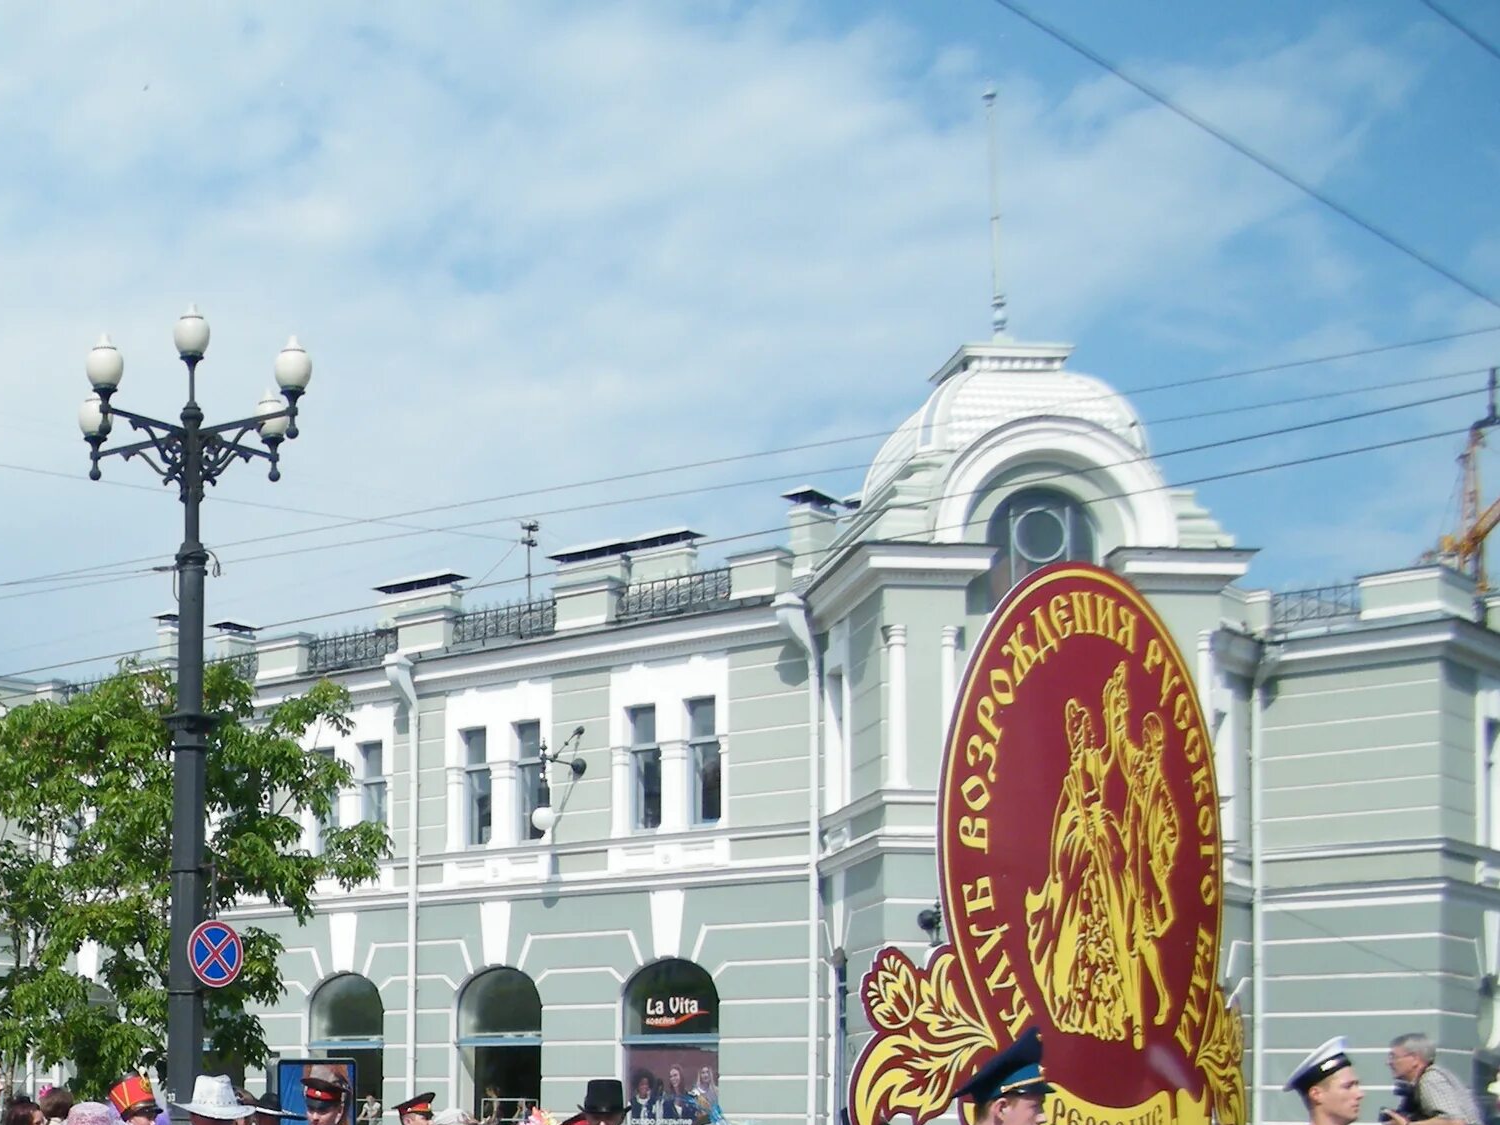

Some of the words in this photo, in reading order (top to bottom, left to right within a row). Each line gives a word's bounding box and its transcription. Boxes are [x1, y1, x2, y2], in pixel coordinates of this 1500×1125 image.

[958, 590, 1137, 855] ВОЗРОЖДЕНИЯ
[1143, 638, 1218, 907] РУССКОГО
[646, 998, 664, 1015] La
[669, 997, 698, 1014] Vita
[961, 875, 1034, 1042] КЛУБ
[1174, 922, 1213, 1057] БАЛА
